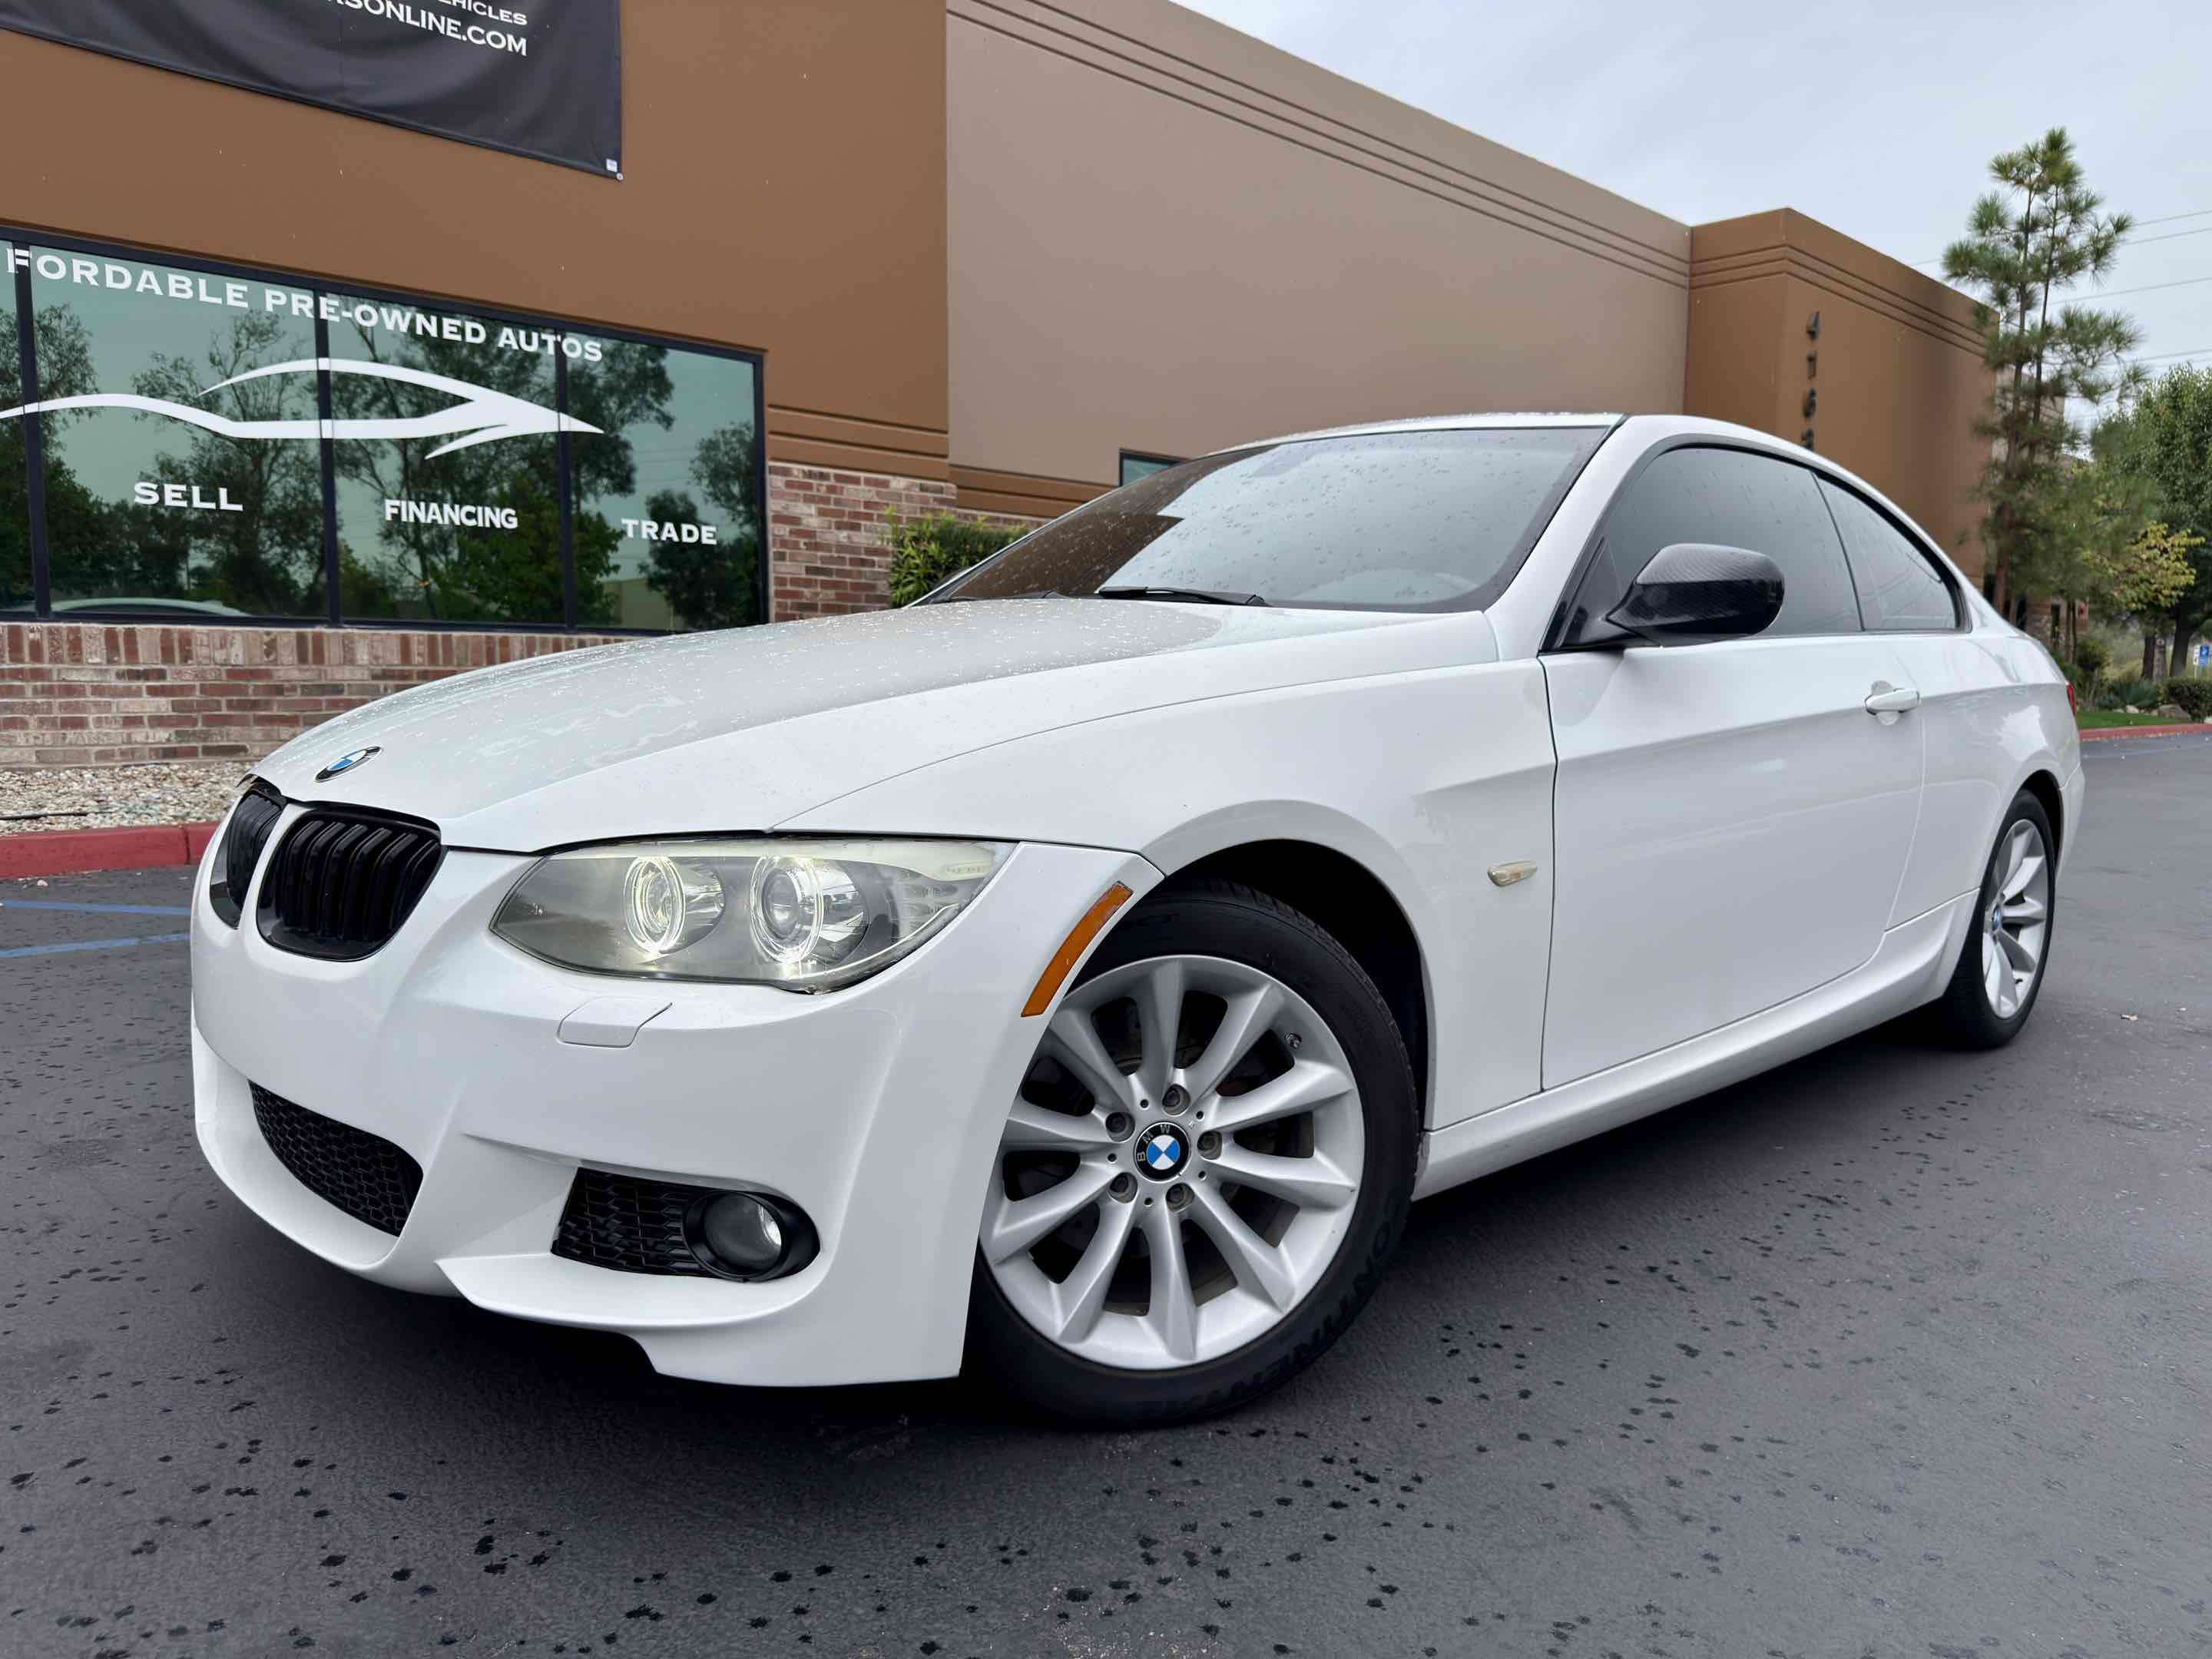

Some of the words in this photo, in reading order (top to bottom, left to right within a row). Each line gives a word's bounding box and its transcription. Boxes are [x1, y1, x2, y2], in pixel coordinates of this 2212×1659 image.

[329, 0, 527, 56] SONLINE.COM
[437, 0, 528, 25] HICLES
[6, 247, 249, 308] FORDABLE
[264, 288, 487, 345] PRE-OWNED
[497, 326, 603, 363] AUTOS
[134, 481, 243, 512] SELL
[384, 498, 519, 529] FINANCING
[621, 518, 717, 545] TRADE
